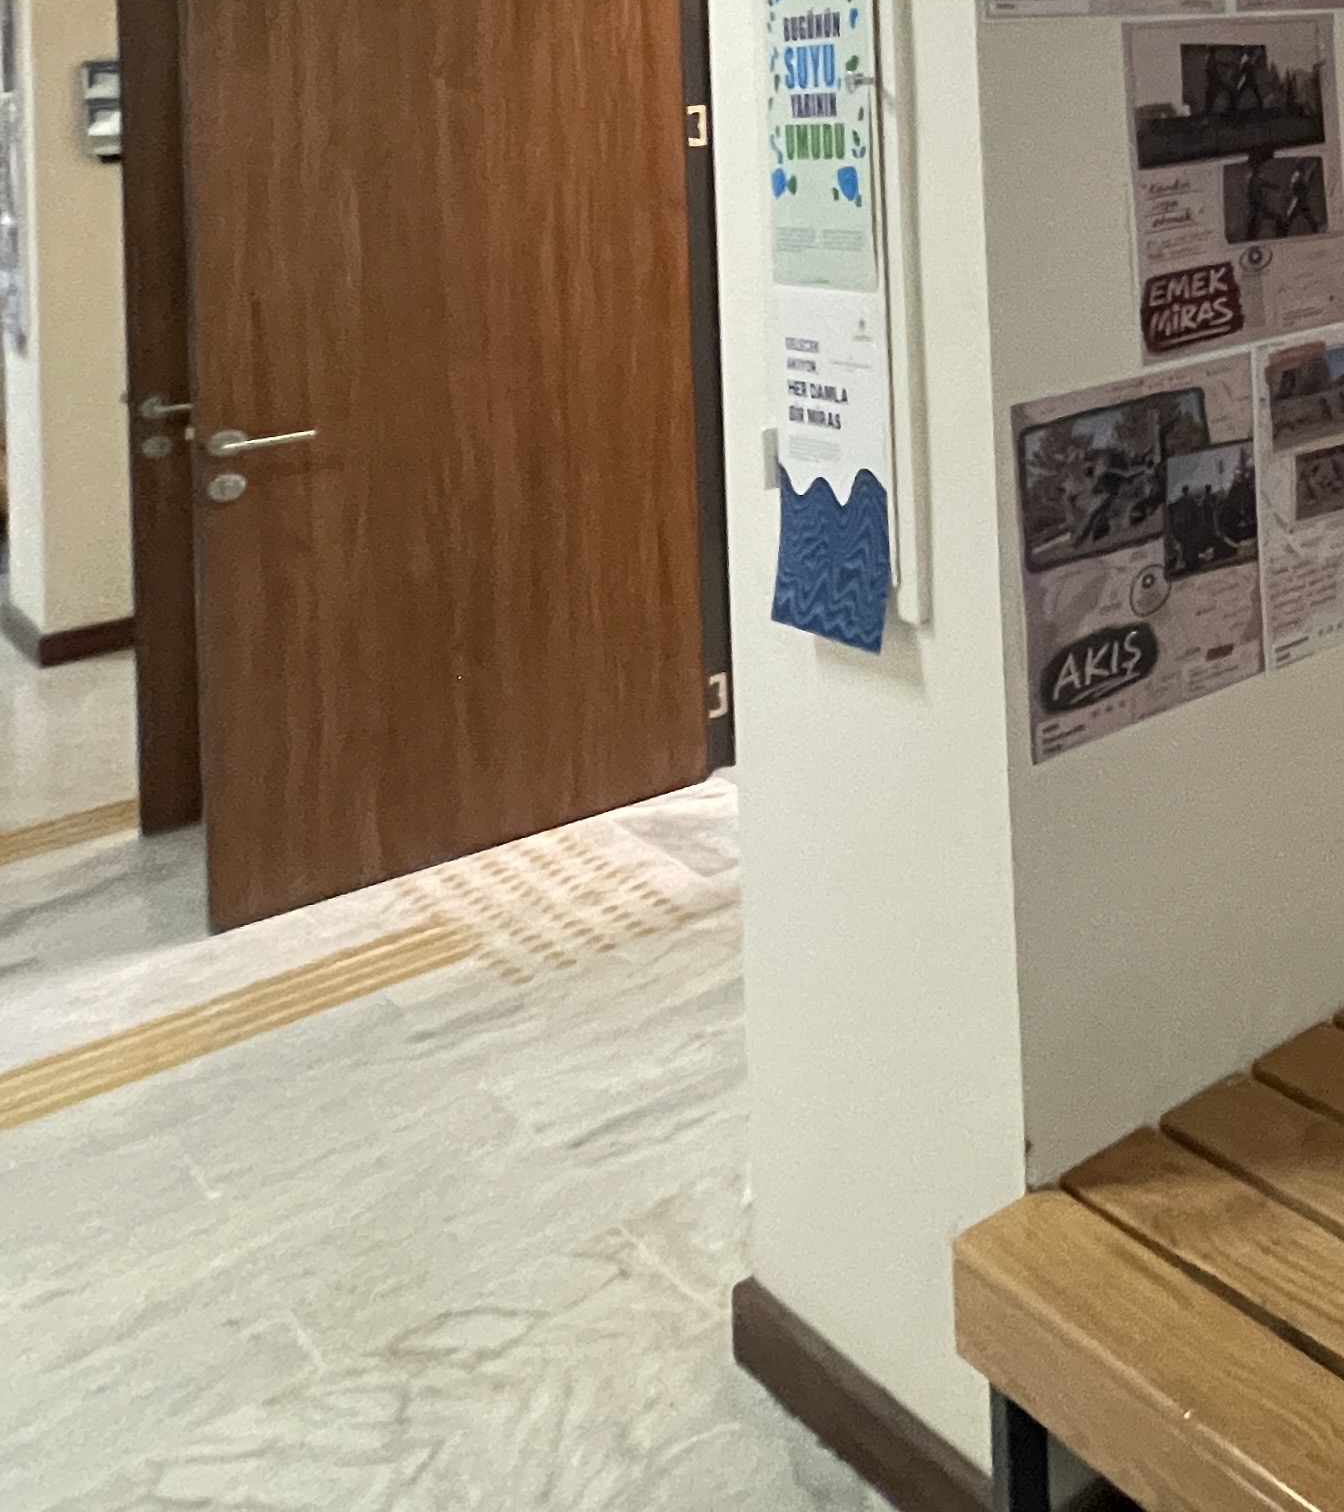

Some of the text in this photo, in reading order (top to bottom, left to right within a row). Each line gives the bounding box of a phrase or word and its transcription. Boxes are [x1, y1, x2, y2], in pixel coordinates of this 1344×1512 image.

[783, 7, 841, 42] BUGÜNÜN
[785, 122, 846, 160] UMUDU
[1149, 267, 1228, 307] EMEK
[1148, 297, 1233, 338] MİRAS
[1051, 630, 1142, 702] AKIŞ
